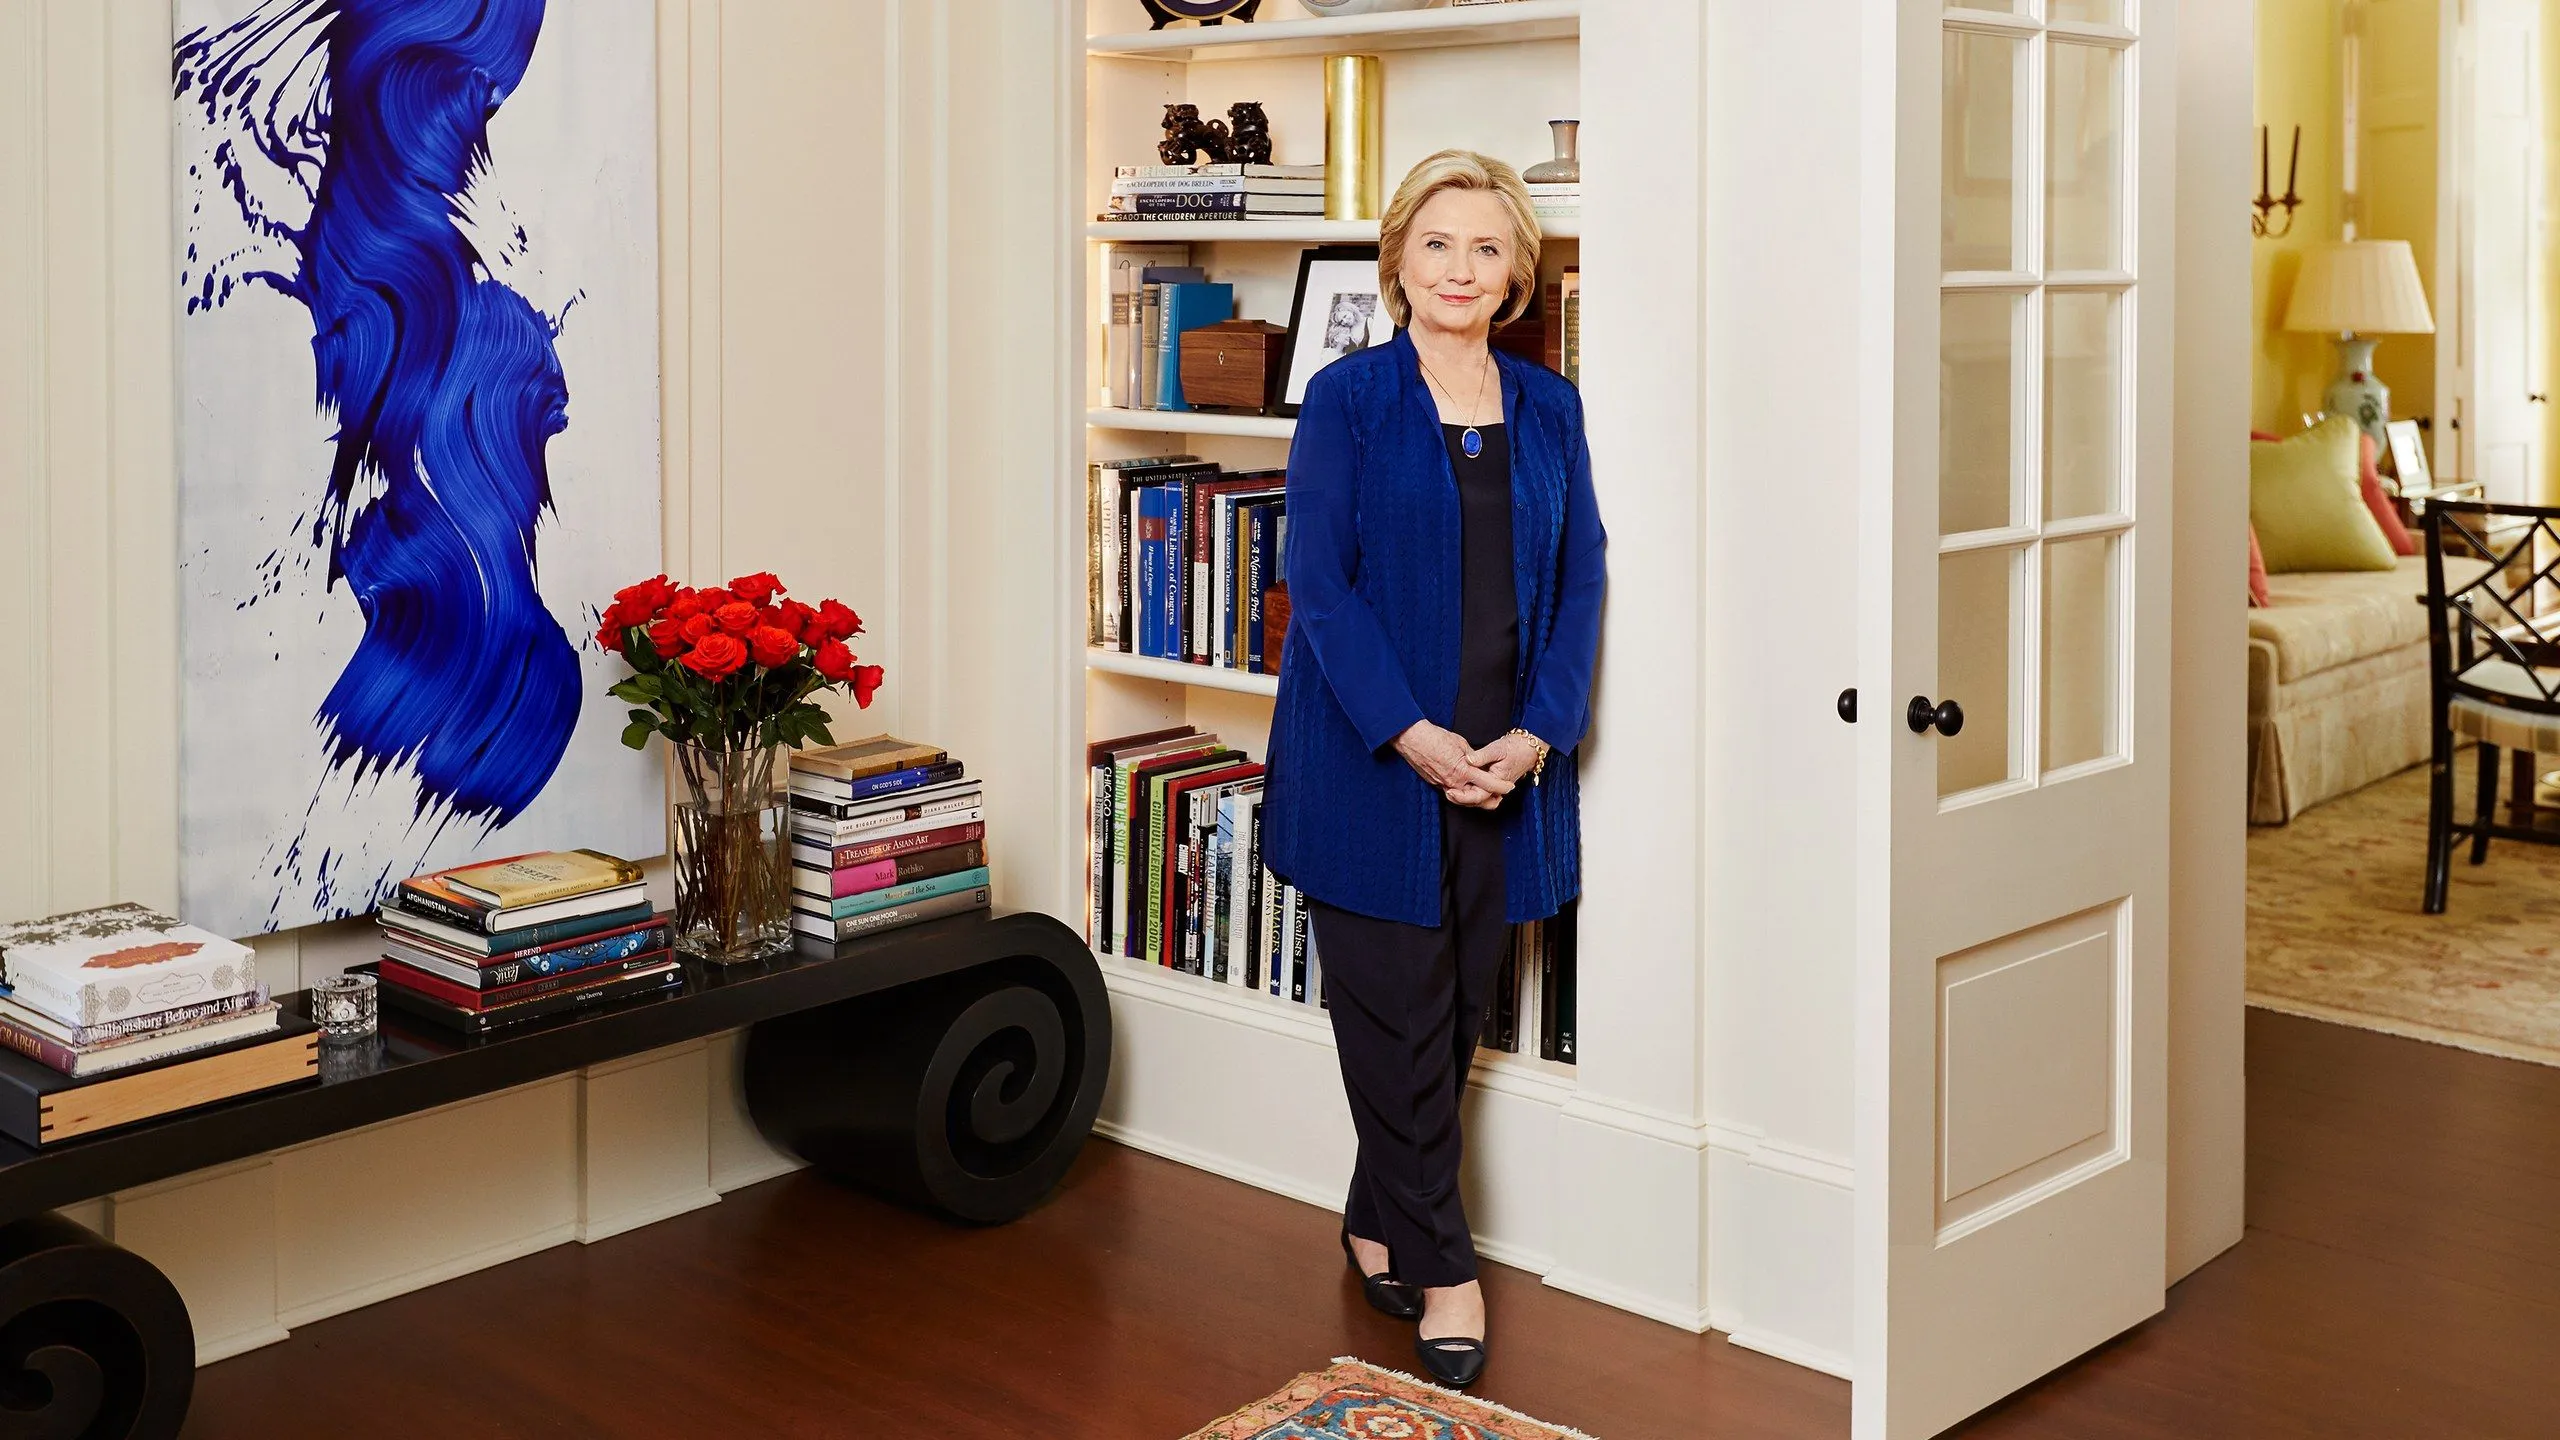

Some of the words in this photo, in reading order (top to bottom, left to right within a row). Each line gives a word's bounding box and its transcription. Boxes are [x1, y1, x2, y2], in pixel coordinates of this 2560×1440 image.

[1175, 193, 1214, 208] DOG
[1142, 213, 1157, 221] THE
[1157, 213, 1196, 221] CHILDREN
[1198, 212, 1238, 220] APERTURE
[1198, 488, 1206, 503] THE
[1198, 505, 1206, 548] PRESIDENT'S
[1167, 537, 1178, 571] Library
[1251, 544, 1260, 554] A
[1168, 573, 1177, 583] of
[1250, 554, 1261, 596] Nation's
[1168, 584, 1178, 626] Congress
[1250, 596, 1261, 622] Pride
[880, 781, 893, 790] GOD'S
[893, 778, 903, 787] SIDE
[1103, 766, 1112, 817] CHICAGO
[1115, 764, 1128, 803] AVEDON
[856, 821, 877, 829] BIGGER
[879, 814, 903, 824] PICTURE
[1094, 796, 1103, 850] BRINGING
[1115, 808, 1127, 826] THE
[1150, 800, 1162, 850] CHIHULY
[844, 847, 880, 860] TREASURES
[881, 844, 892, 853] OF
[893, 838, 915, 851] ASIAN
[915, 834, 930, 846] ART
[1113, 829, 1126, 865] SIXTIES
[1253, 818, 1261, 853] Alexander
[874, 868, 895, 882] Mark
[898, 862, 925, 877] Rothko
[1093, 851, 1103, 883] BACK
[1178, 843, 1189, 875] CHIHULY
[1208, 848, 1217, 879] TEAM
[1252, 853, 1260, 876] Calder
[570, 882, 591, 891] AMERICA
[925, 883, 937, 892] Sea
[1149, 849, 1161, 920] JERUSALEM
[406, 892, 447, 914] AFGHANISTAN
[1093, 906, 1102, 925] BAY
[1206, 880, 1216, 931] CHIHULY
[845, 920, 858, 928] ONE
[858, 917, 869, 926] SUN
[869, 915, 881, 924] ONE
[881, 910, 898, 921] MOON
[893, 912, 918, 924] AUSTRALIA
[1271, 903, 1284, 954] IMAGES
[1148, 920, 1159, 951] 2000
[1294, 909, 1308, 957] Realists
[514, 946, 542, 959] HEREND
[88, 1015, 164, 1040] Williamsburg
[165, 1008, 199, 1023] Before
[199, 1001, 220, 1016] and
[221, 995, 250, 1012] After
